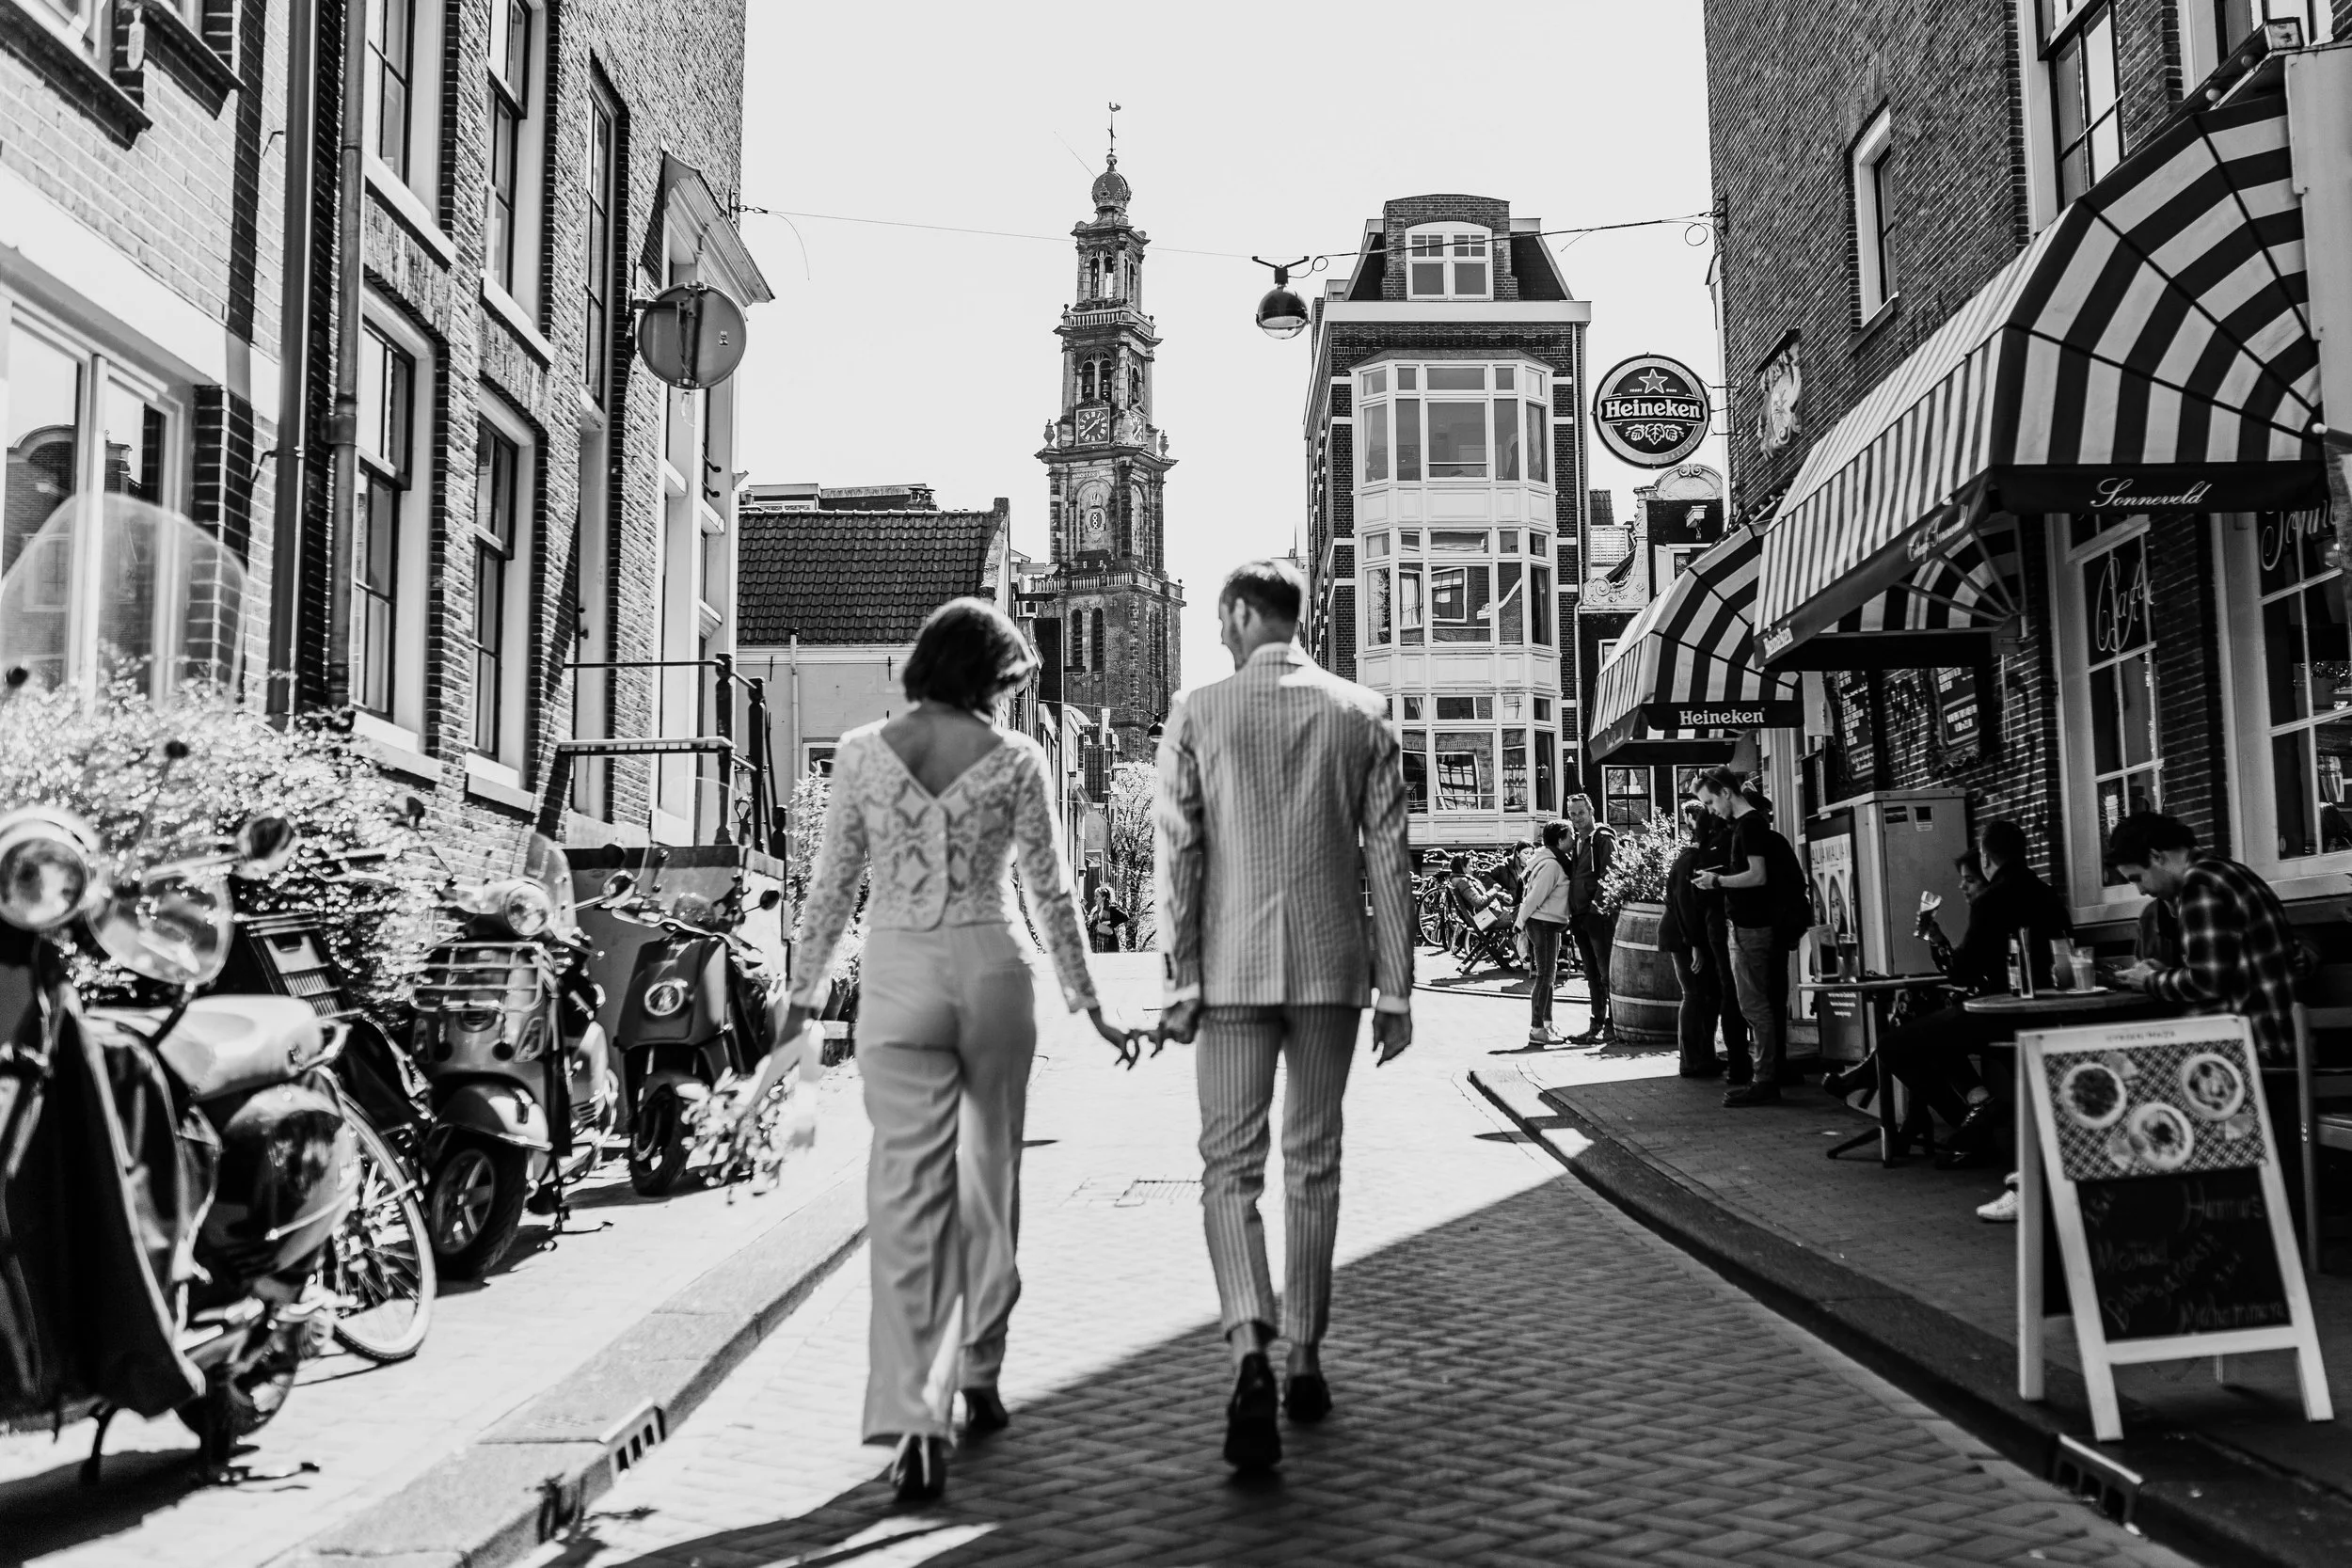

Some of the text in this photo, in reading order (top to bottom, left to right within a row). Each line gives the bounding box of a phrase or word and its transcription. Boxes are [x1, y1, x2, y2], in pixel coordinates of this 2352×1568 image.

[1605, 399, 1701, 419] Heineken
[2090, 478, 2213, 507] Sonneveld
[1679, 709, 1765, 726] Heineken
